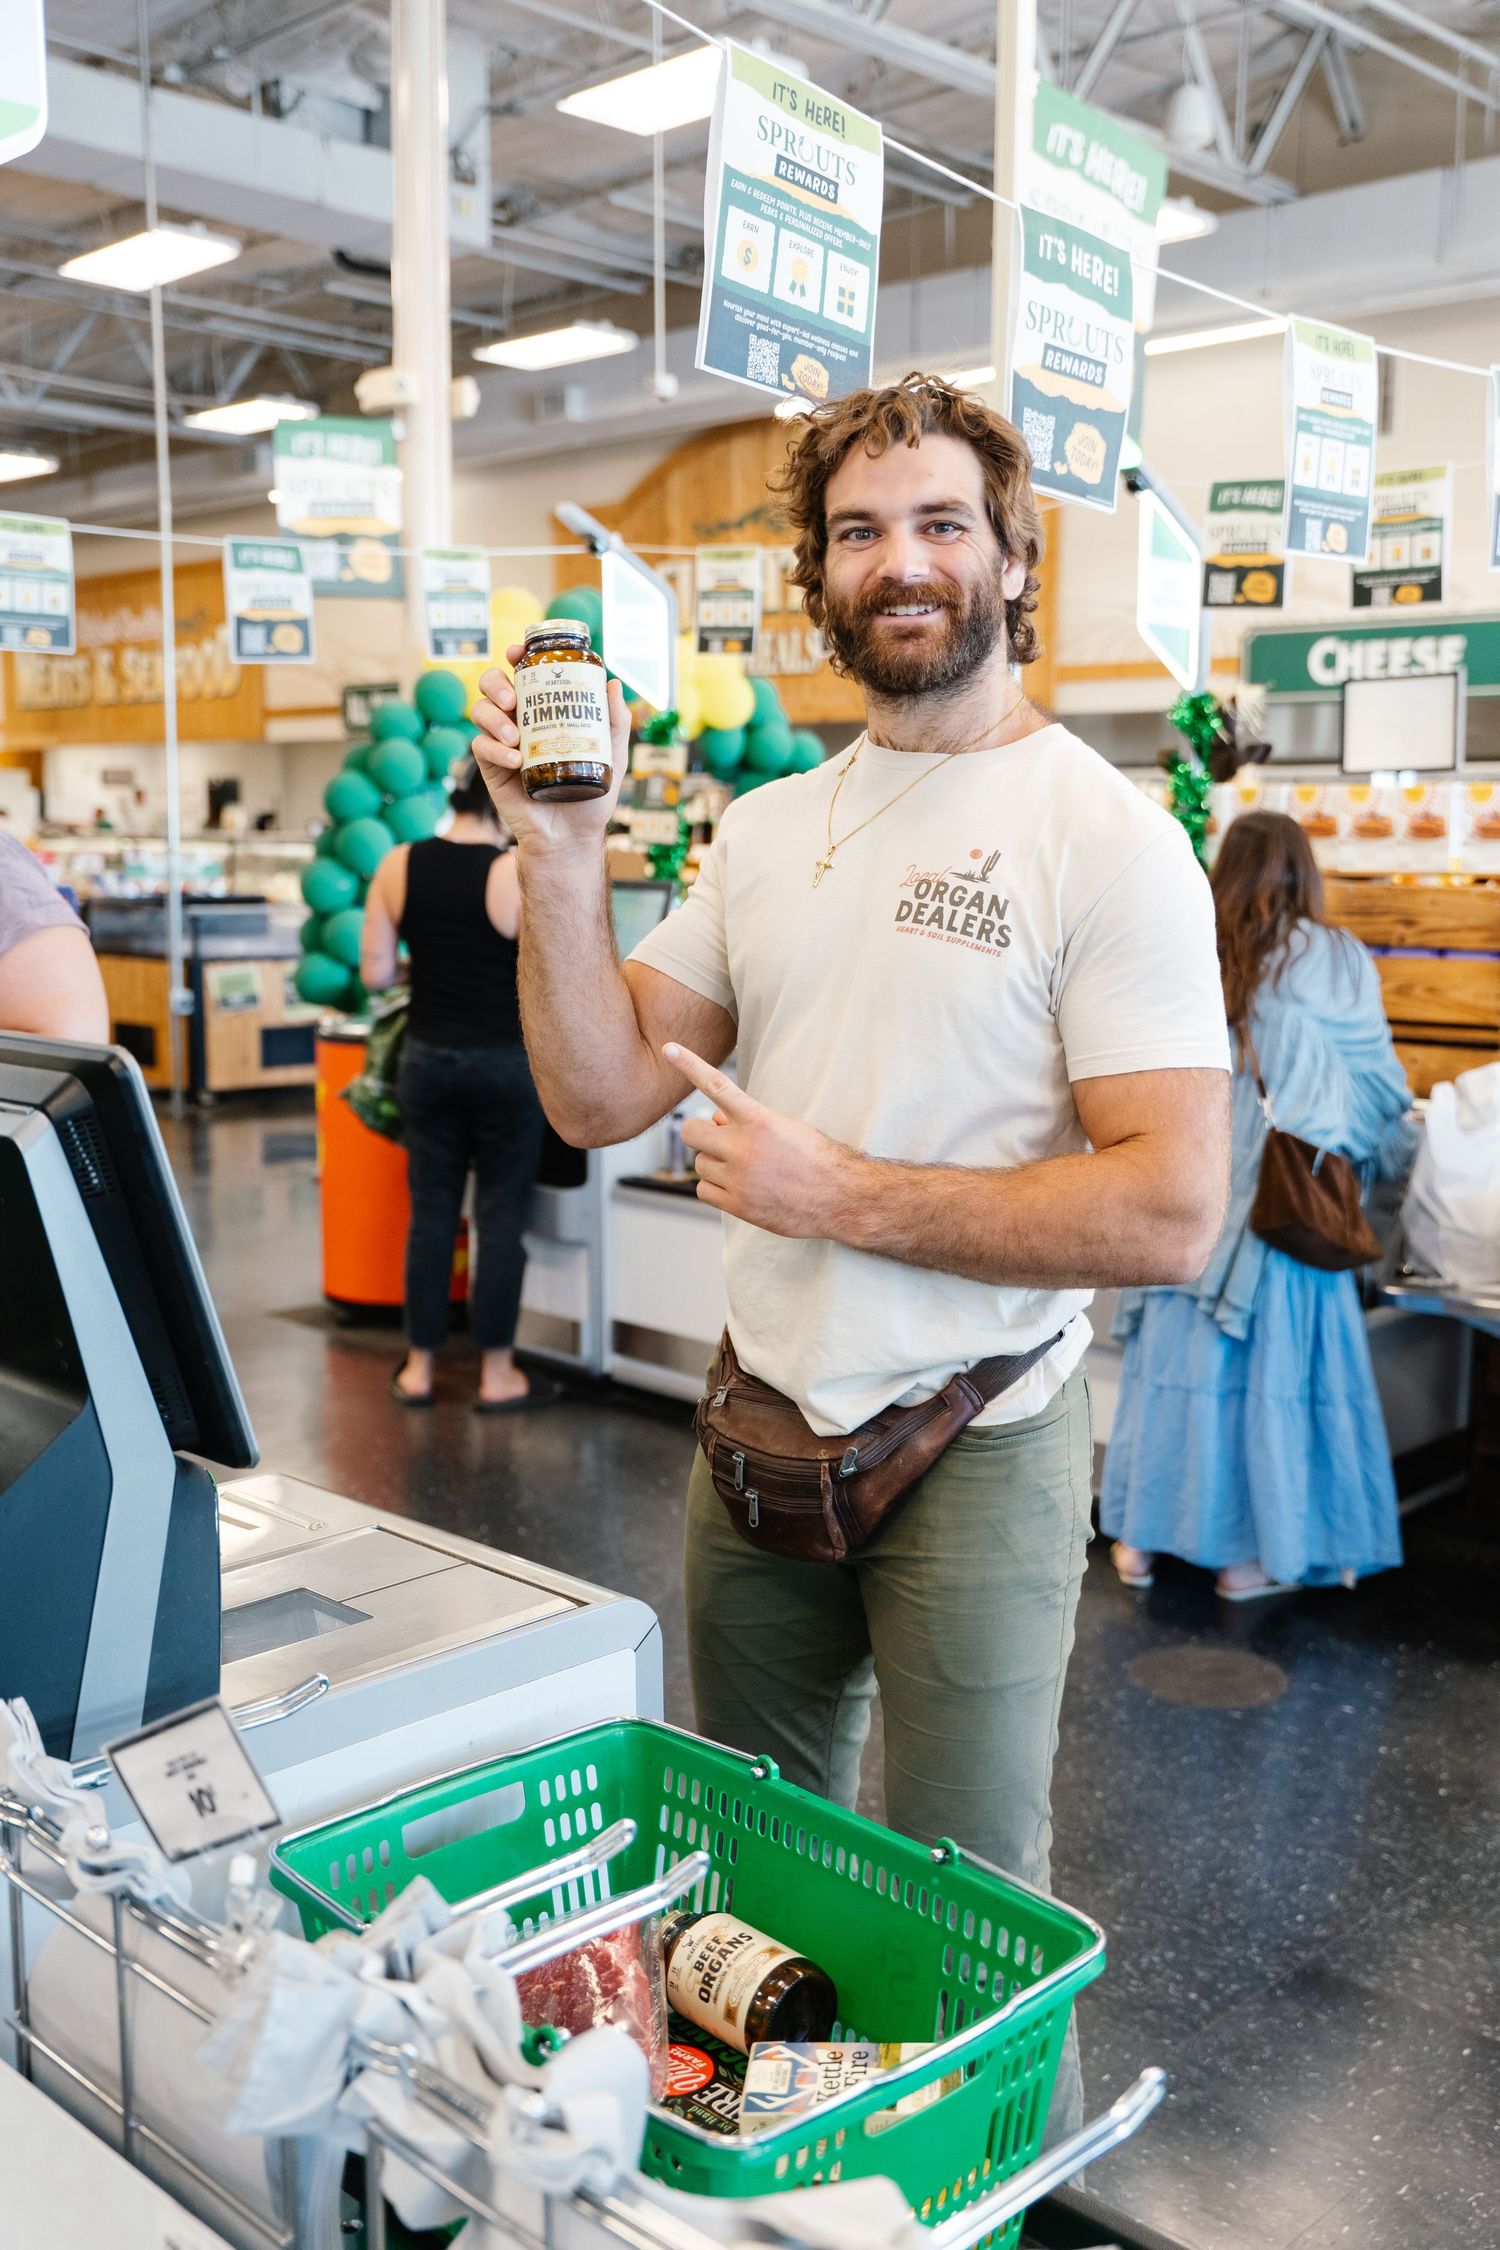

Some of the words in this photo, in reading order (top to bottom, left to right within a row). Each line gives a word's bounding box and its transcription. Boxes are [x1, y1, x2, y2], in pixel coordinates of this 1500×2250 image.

[772, 81, 798, 112] IT'S
[757, 115, 857, 187] SPROUTS
[1046, 122, 1086, 166] IT'S
[730, 178, 747, 193] EARN
[753, 189, 775, 205] REDEEM
[778, 159, 837, 200] REWARDS
[760, 203, 778, 219] PERKS
[742, 220, 760, 234] EARN
[788, 240, 814, 258] EXPLORE
[1038, 233, 1066, 265] IT'S
[1071, 243, 1120, 298] HERE!
[1025, 300, 1126, 365] SPROUTS
[798, 371, 824, 393] TODAY!
[803, 363, 821, 377] JOIN
[1045, 348, 1104, 386] REWARDS
[1071, 446, 1100, 474] TODAY!
[1077, 432, 1098, 455] JOIN
[523, 712, 530, 727] &
[533, 705, 602, 724] IMMUNE
[526, 691, 596, 708] HISTAMINE
[899, 864, 953, 888] Local
[914, 878, 1009, 920] ORGAN
[894, 900, 1012, 948] DEALERS
[896, 926, 920, 936] HEART
[926, 931, 944, 941] SOIL
[946, 935, 1003, 958] SUPPLEMENTS
[693, 1936, 722, 1973] BEEF
[698, 1932, 753, 2004] ORGANS
[669, 2047, 707, 2069] FARMS
[844, 2049, 869, 2089] Fire
[816, 2051, 844, 2103] Kettle
[687, 2105, 718, 2125] Hand
